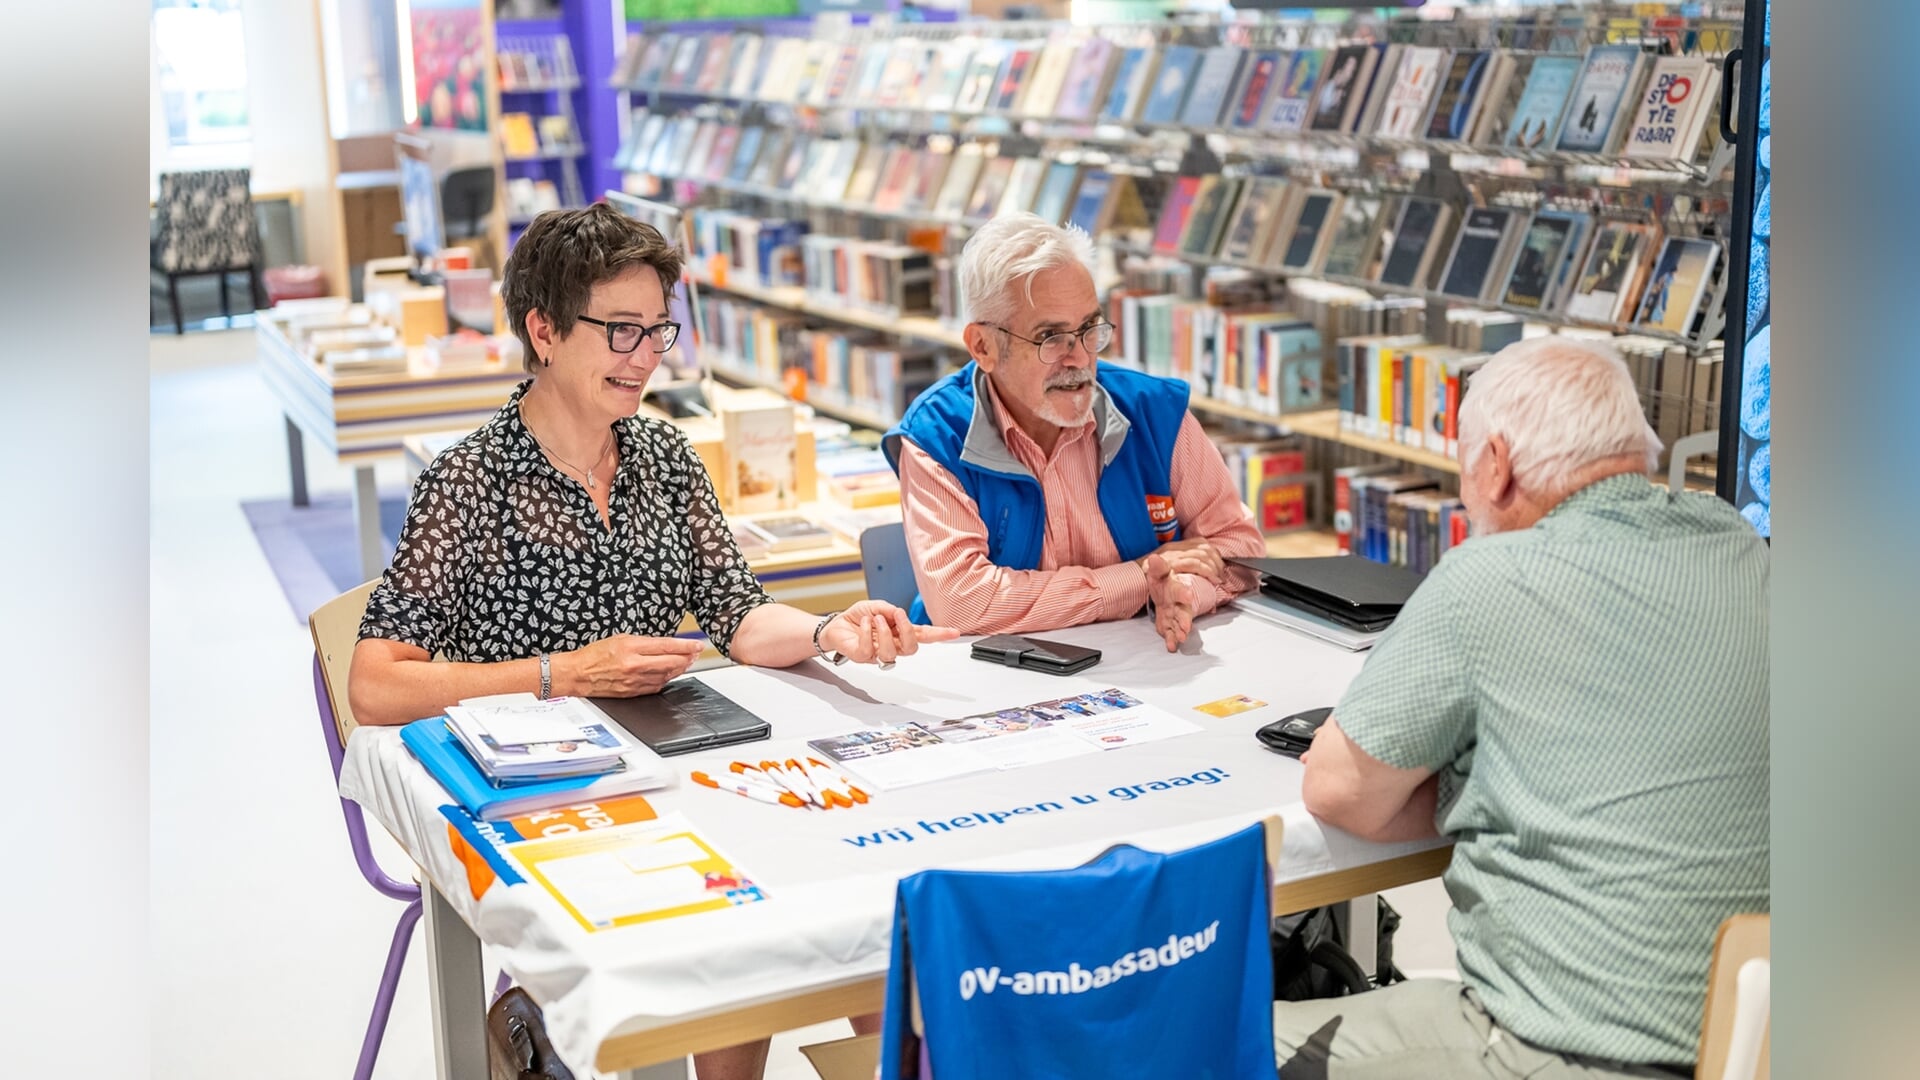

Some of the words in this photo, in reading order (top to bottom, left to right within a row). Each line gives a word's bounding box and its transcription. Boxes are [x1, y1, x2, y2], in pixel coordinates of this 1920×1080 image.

[842, 827, 914, 848] Wij
[917, 801, 1064, 834] helpen
[1070, 794, 1099, 805] u
[1108, 767, 1231, 801] graag!
[959, 919, 1220, 1001] OV-ambassadeur
